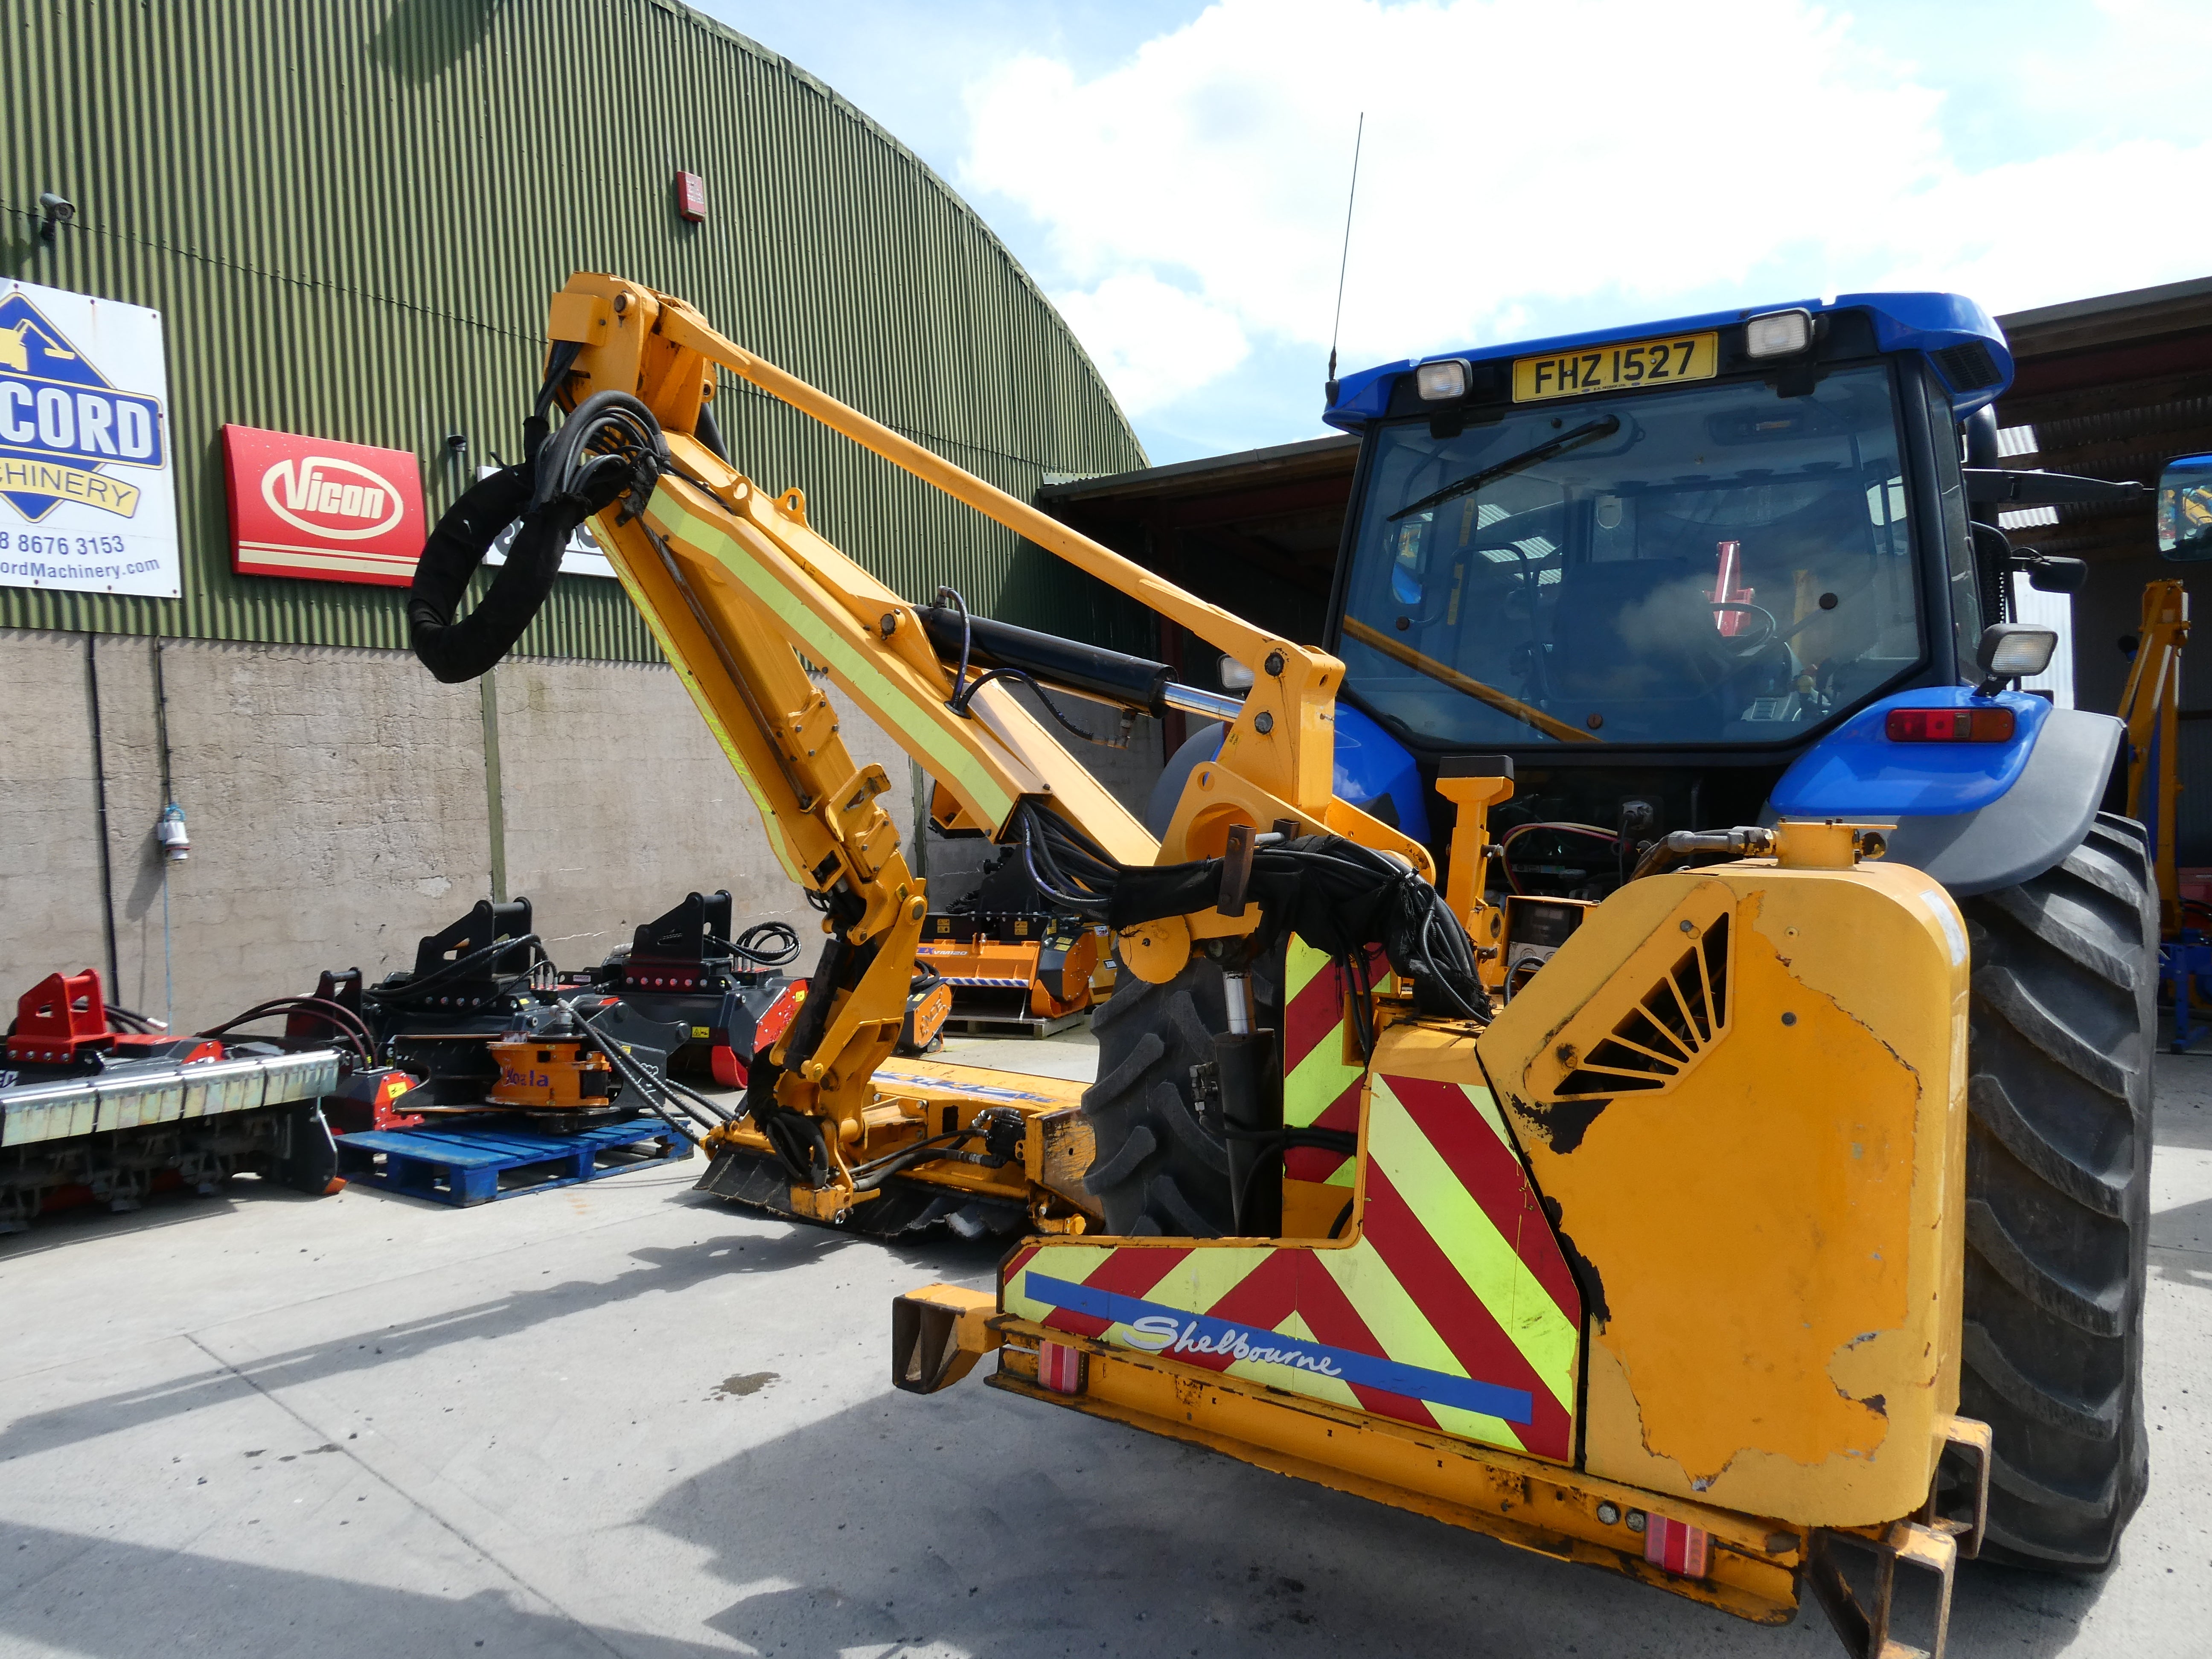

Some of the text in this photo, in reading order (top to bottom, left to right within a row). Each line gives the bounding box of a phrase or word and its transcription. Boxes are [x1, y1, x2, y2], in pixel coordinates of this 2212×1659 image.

[1535, 341, 1695, 393] FHZ 1527
[0, 381, 153, 459] CORD
[276, 457, 386, 520] Vicon
[0, 559, 160, 579] ordMachinery.com
[18, 534, 69, 555] 8676
[76, 536, 125, 555] 3153
[1122, 1316, 1342, 1376] Shelbourne
